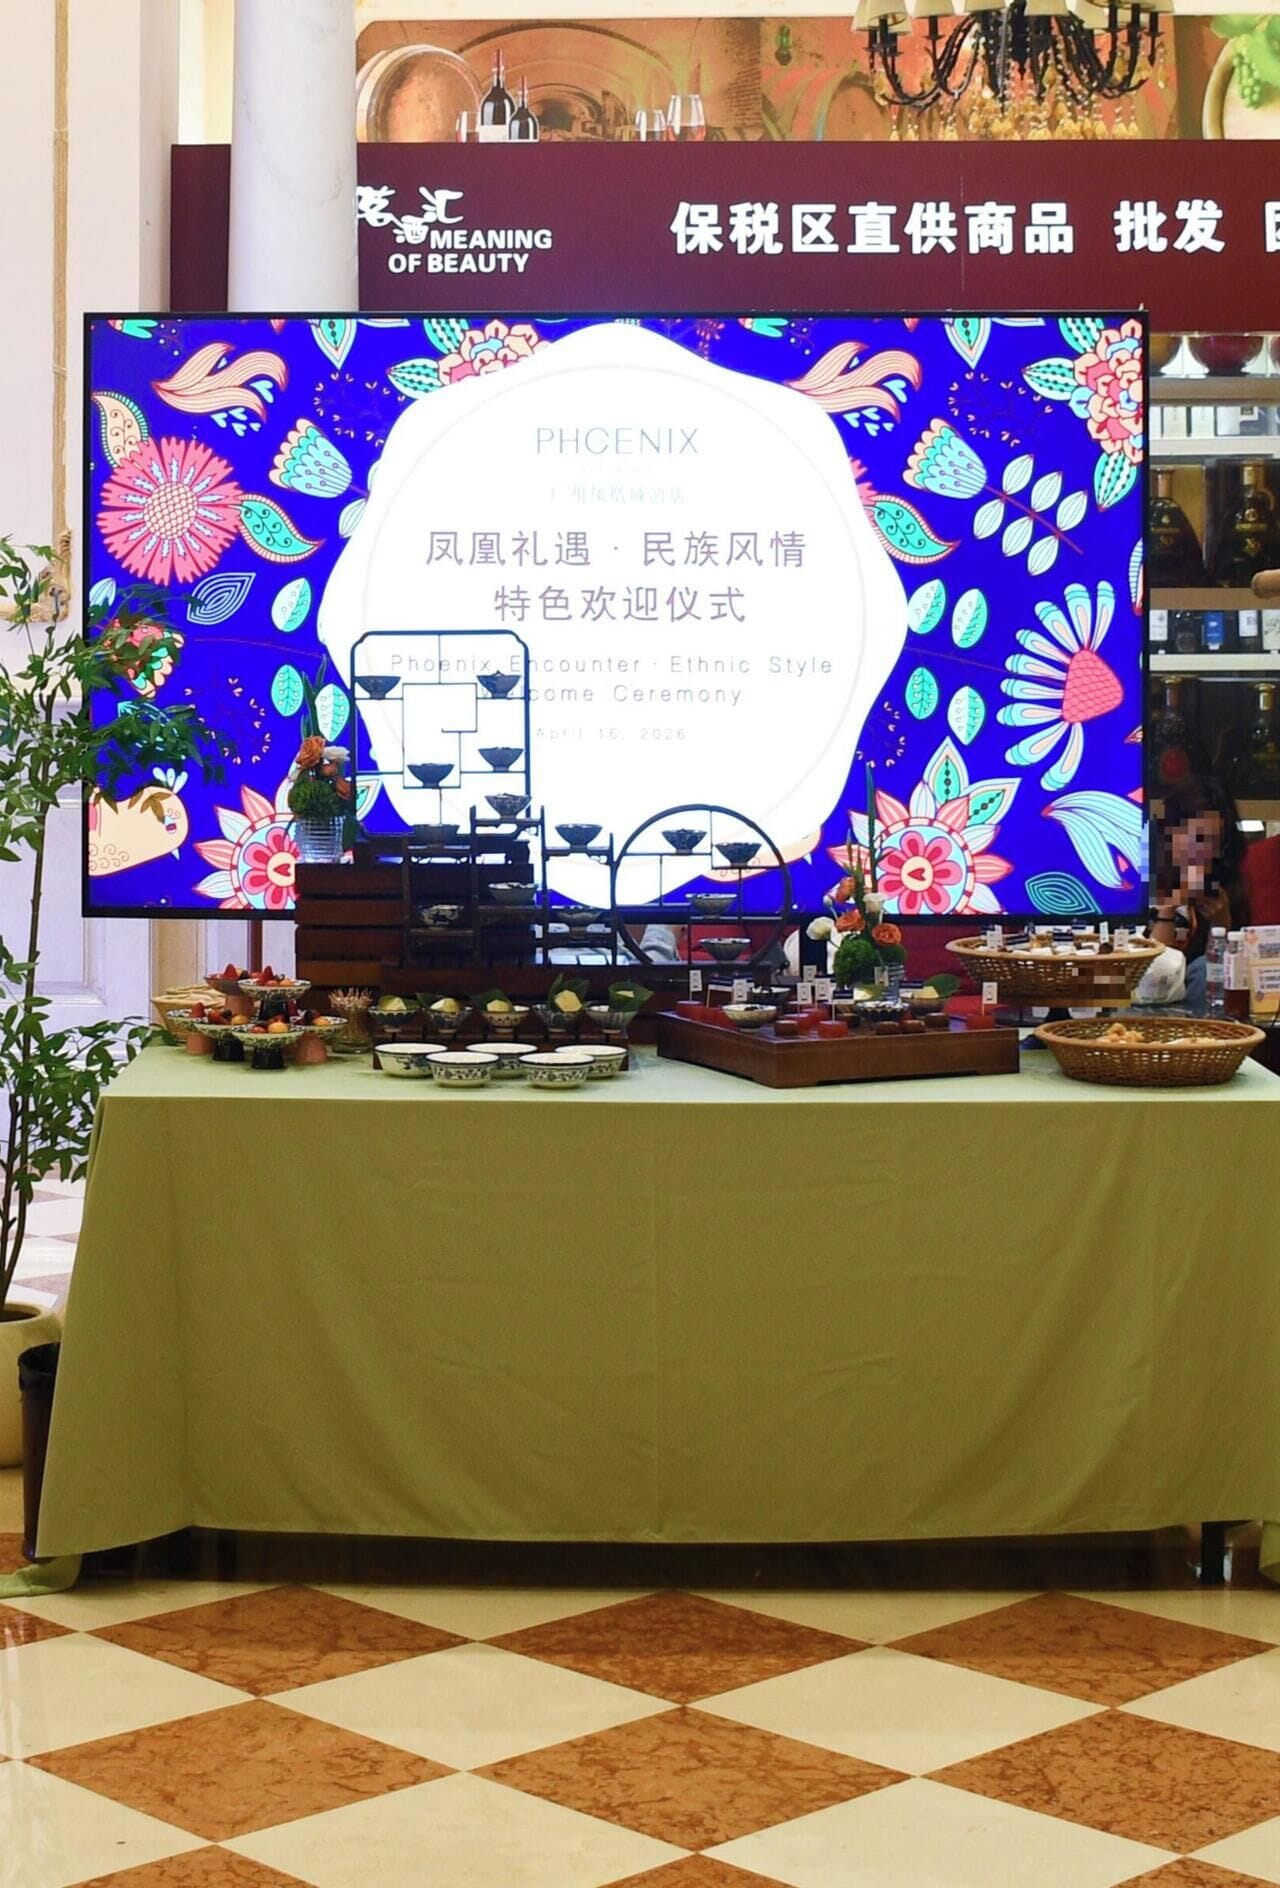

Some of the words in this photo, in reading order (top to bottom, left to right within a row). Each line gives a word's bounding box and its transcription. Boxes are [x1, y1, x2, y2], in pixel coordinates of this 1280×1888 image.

[430, 228, 553, 250] MEANING
[670, 202, 1074, 255] 保税区直供商品
[1113, 199, 1226, 253] 批发
[387, 253, 422, 273] OF
[427, 253, 529, 273] BEAUTY
[493, 586, 746, 623] 特色欢迎仪式
[391, 654, 491, 673] Phoenix
[510, 654, 641, 673] Encounter
[670, 654, 751, 673] Ethnic
[769, 654, 833, 678] Style
[613, 683, 742, 707] Ceremony
